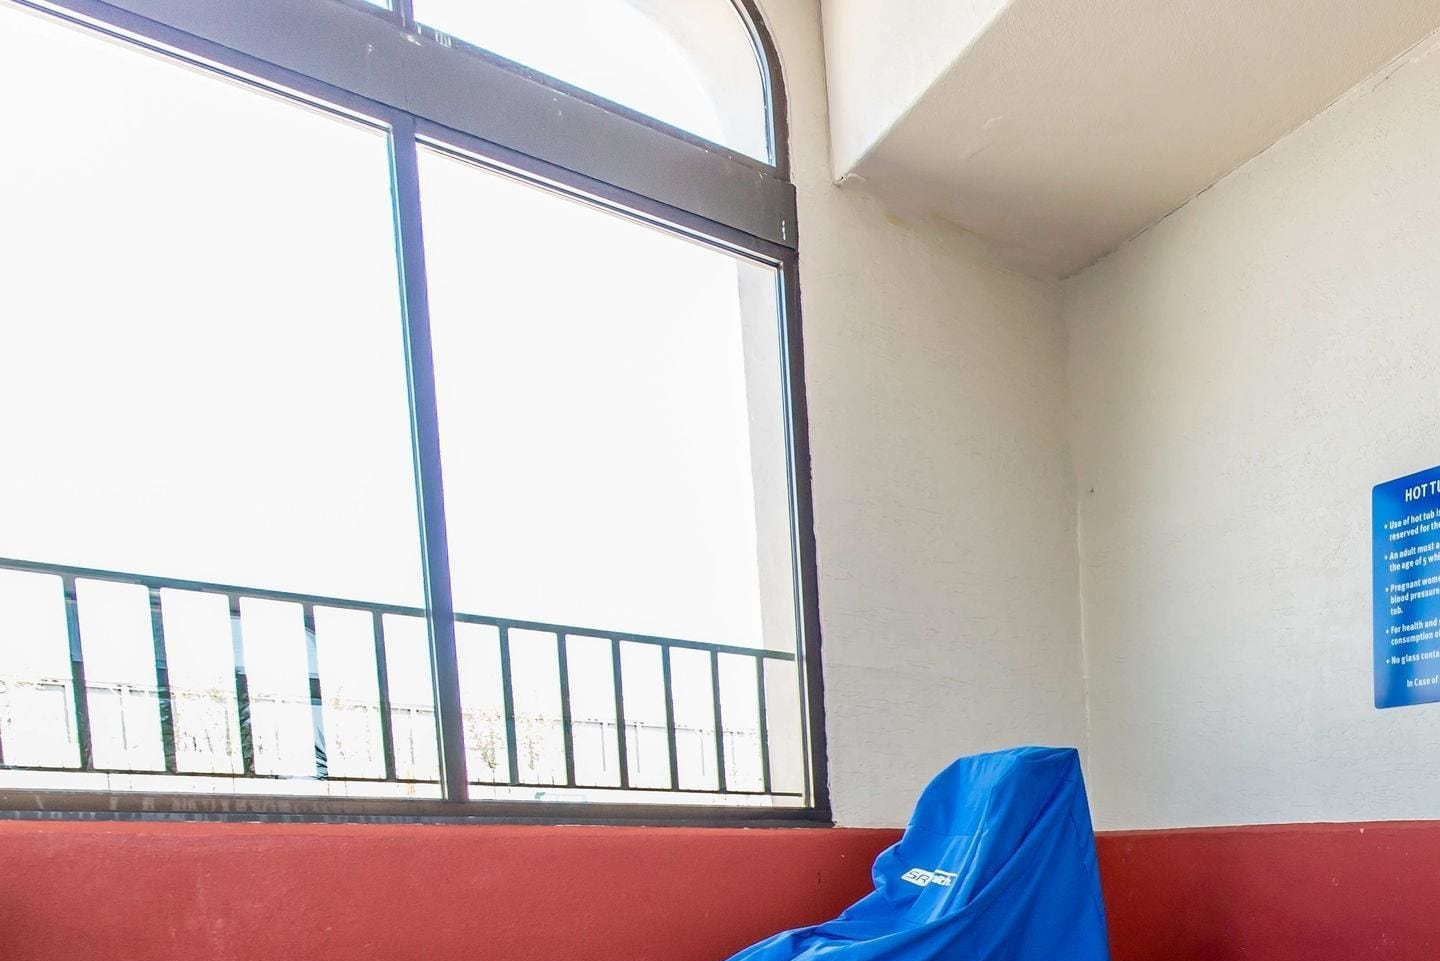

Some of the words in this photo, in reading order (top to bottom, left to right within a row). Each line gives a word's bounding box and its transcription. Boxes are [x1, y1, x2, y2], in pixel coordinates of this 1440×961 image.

[1405, 483, 1428, 502] HOT
[1390, 521, 1402, 529] Use
[1403, 516, 1409, 525] of
[1411, 514, 1422, 523] hot
[1423, 510, 1434, 519] tub
[1390, 526, 1418, 541] reserved
[1420, 524, 1430, 532] for
[1390, 552, 1398, 560] An
[1400, 547, 1416, 558] adult
[1417, 542, 1434, 553] must
[1390, 563, 1400, 572] the
[1402, 561, 1413, 570] age
[1415, 556, 1421, 566] of
[1390, 579, 1420, 592] Pregnant
[1390, 593, 1409, 604] blood
[1411, 588, 1439, 602] pressure
[1391, 606, 1403, 615] tub.
[1391, 626, 1400, 634] For
[1402, 621, 1423, 631] health
[1425, 618, 1437, 628] and
[1391, 629, 1433, 645] consumption
[1435, 629, 1440, 638] of
[1392, 656, 1400, 664] No
[1402, 654, 1419, 664] glass
[1414, 677, 1430, 686] Case
[1432, 675, 1438, 684] of
